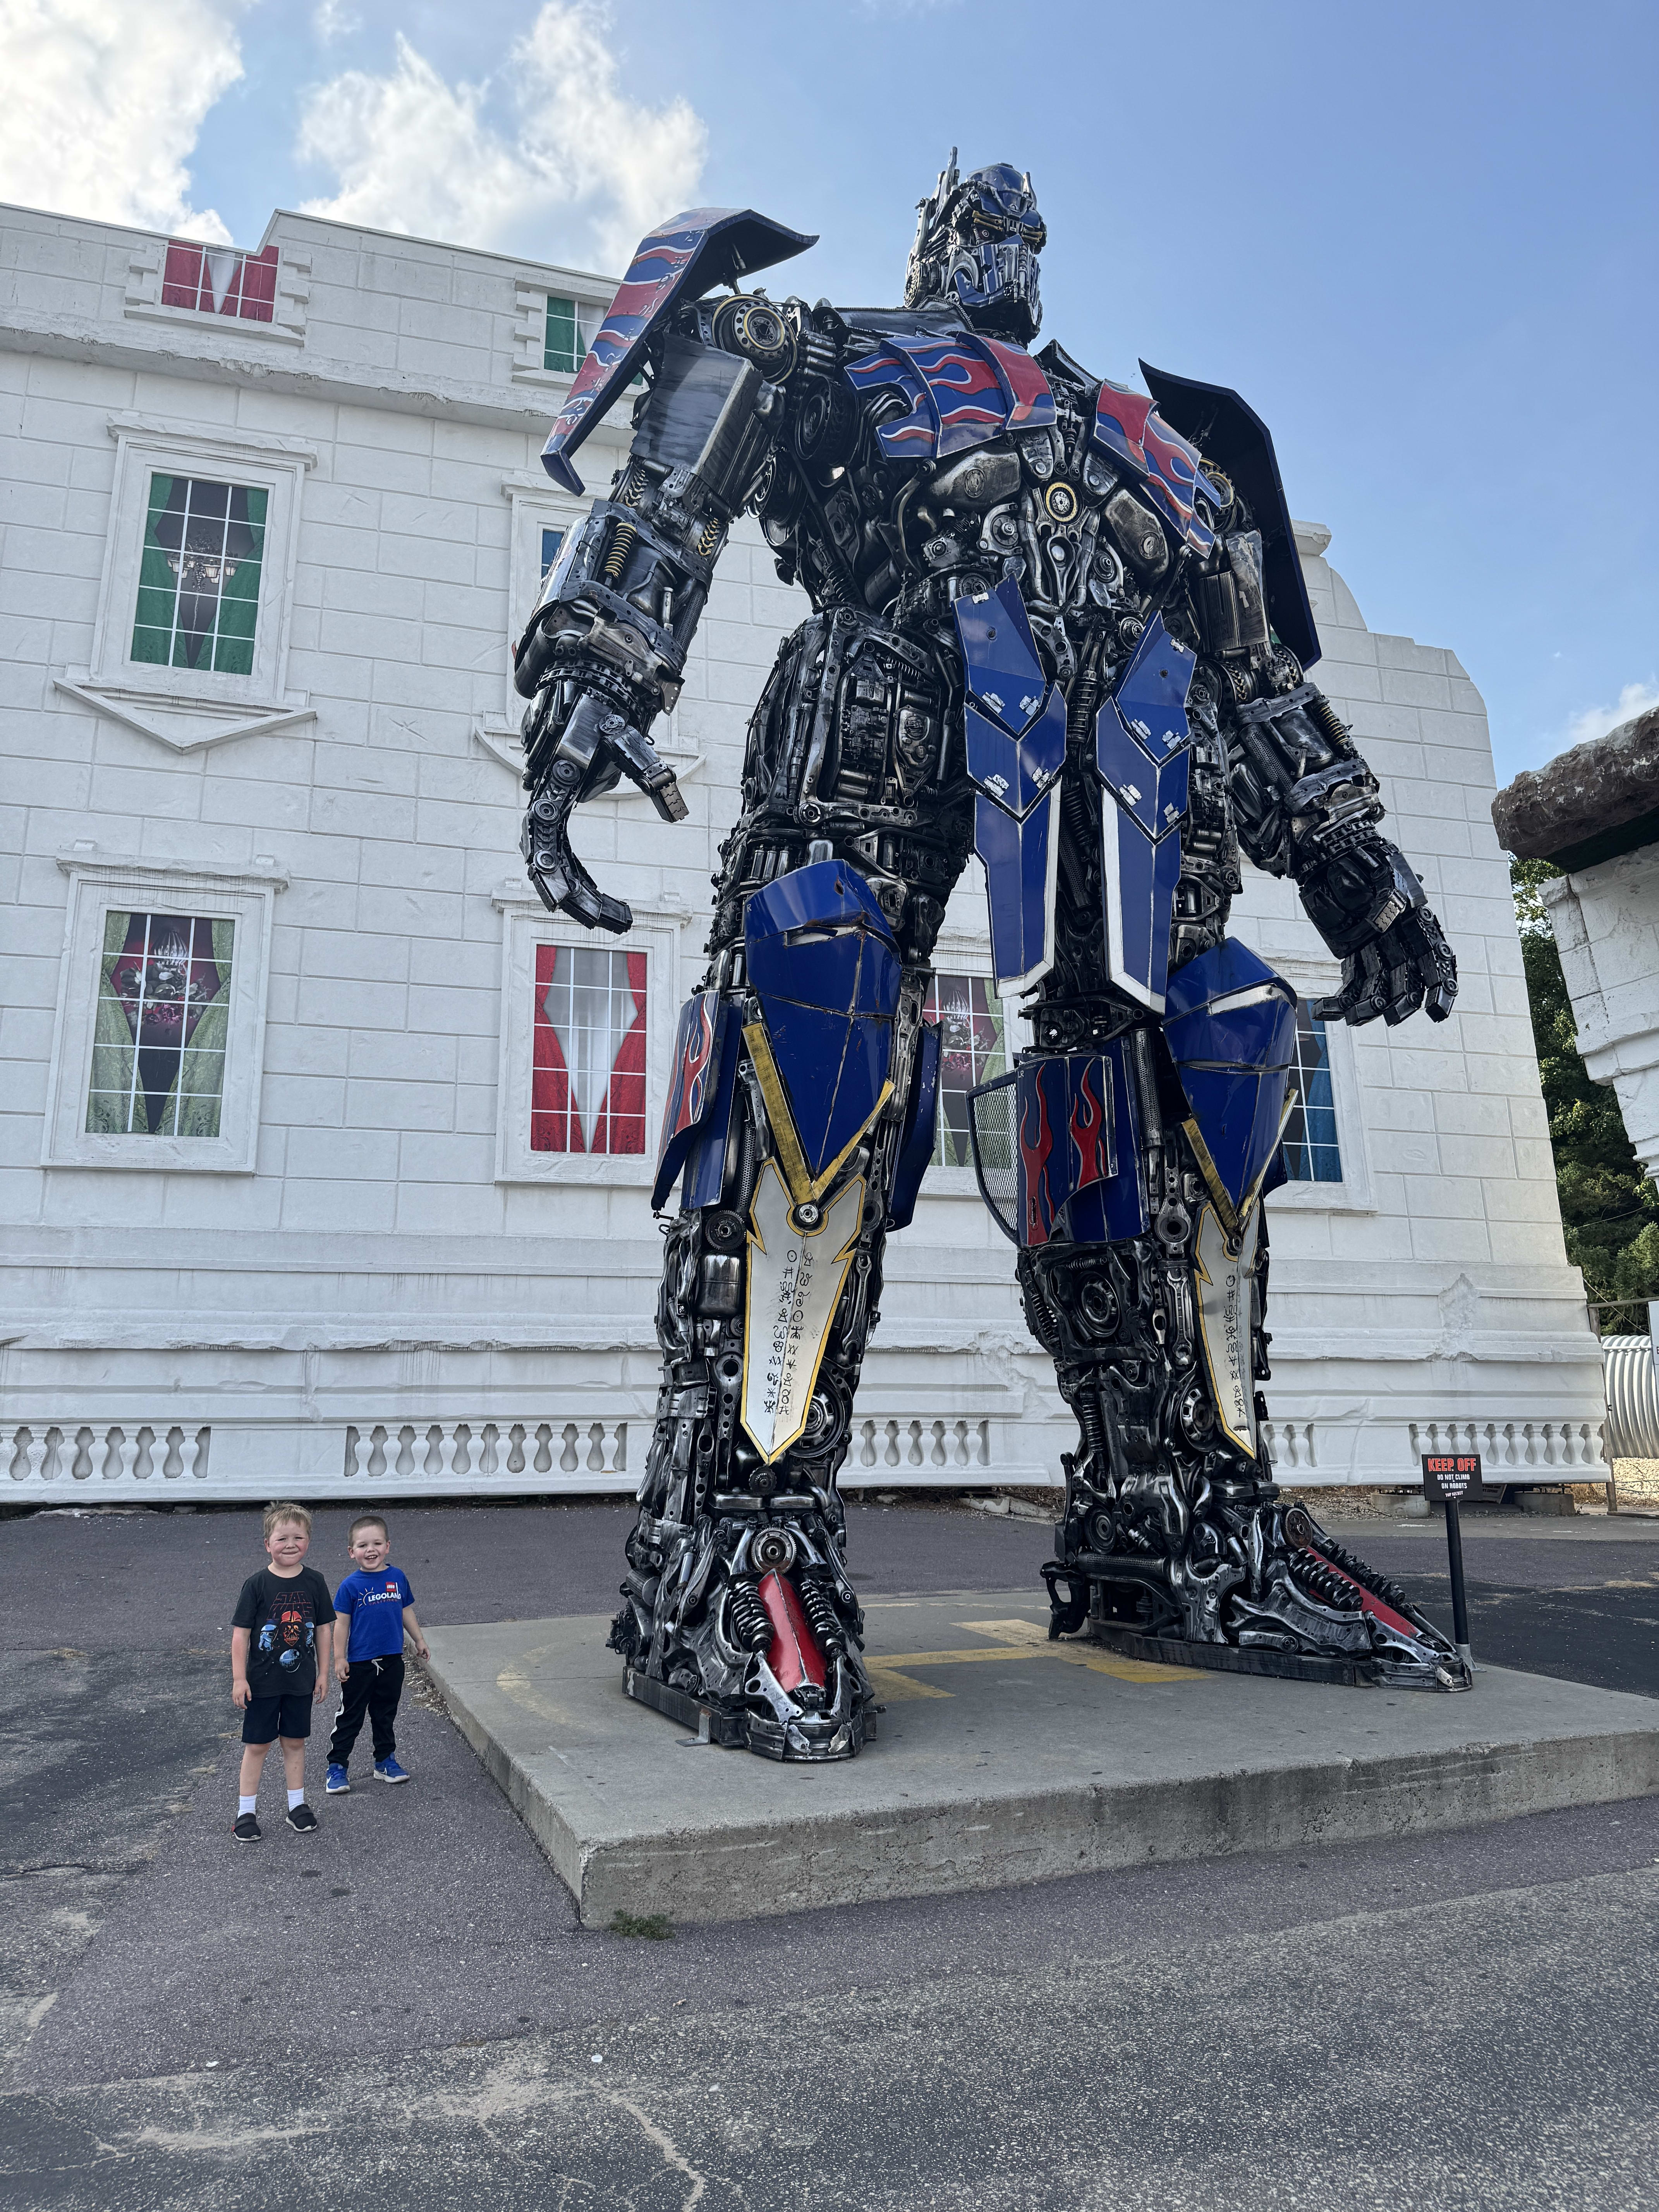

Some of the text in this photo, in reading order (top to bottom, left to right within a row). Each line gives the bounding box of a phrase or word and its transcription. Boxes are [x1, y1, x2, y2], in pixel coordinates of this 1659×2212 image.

[1427, 1458, 1476, 1472] KEEP OFF
[273, 1591, 311, 1604] STAR
[368, 1592, 402, 1602] LEGOLAND
[266, 1603, 313, 1620] WARS
